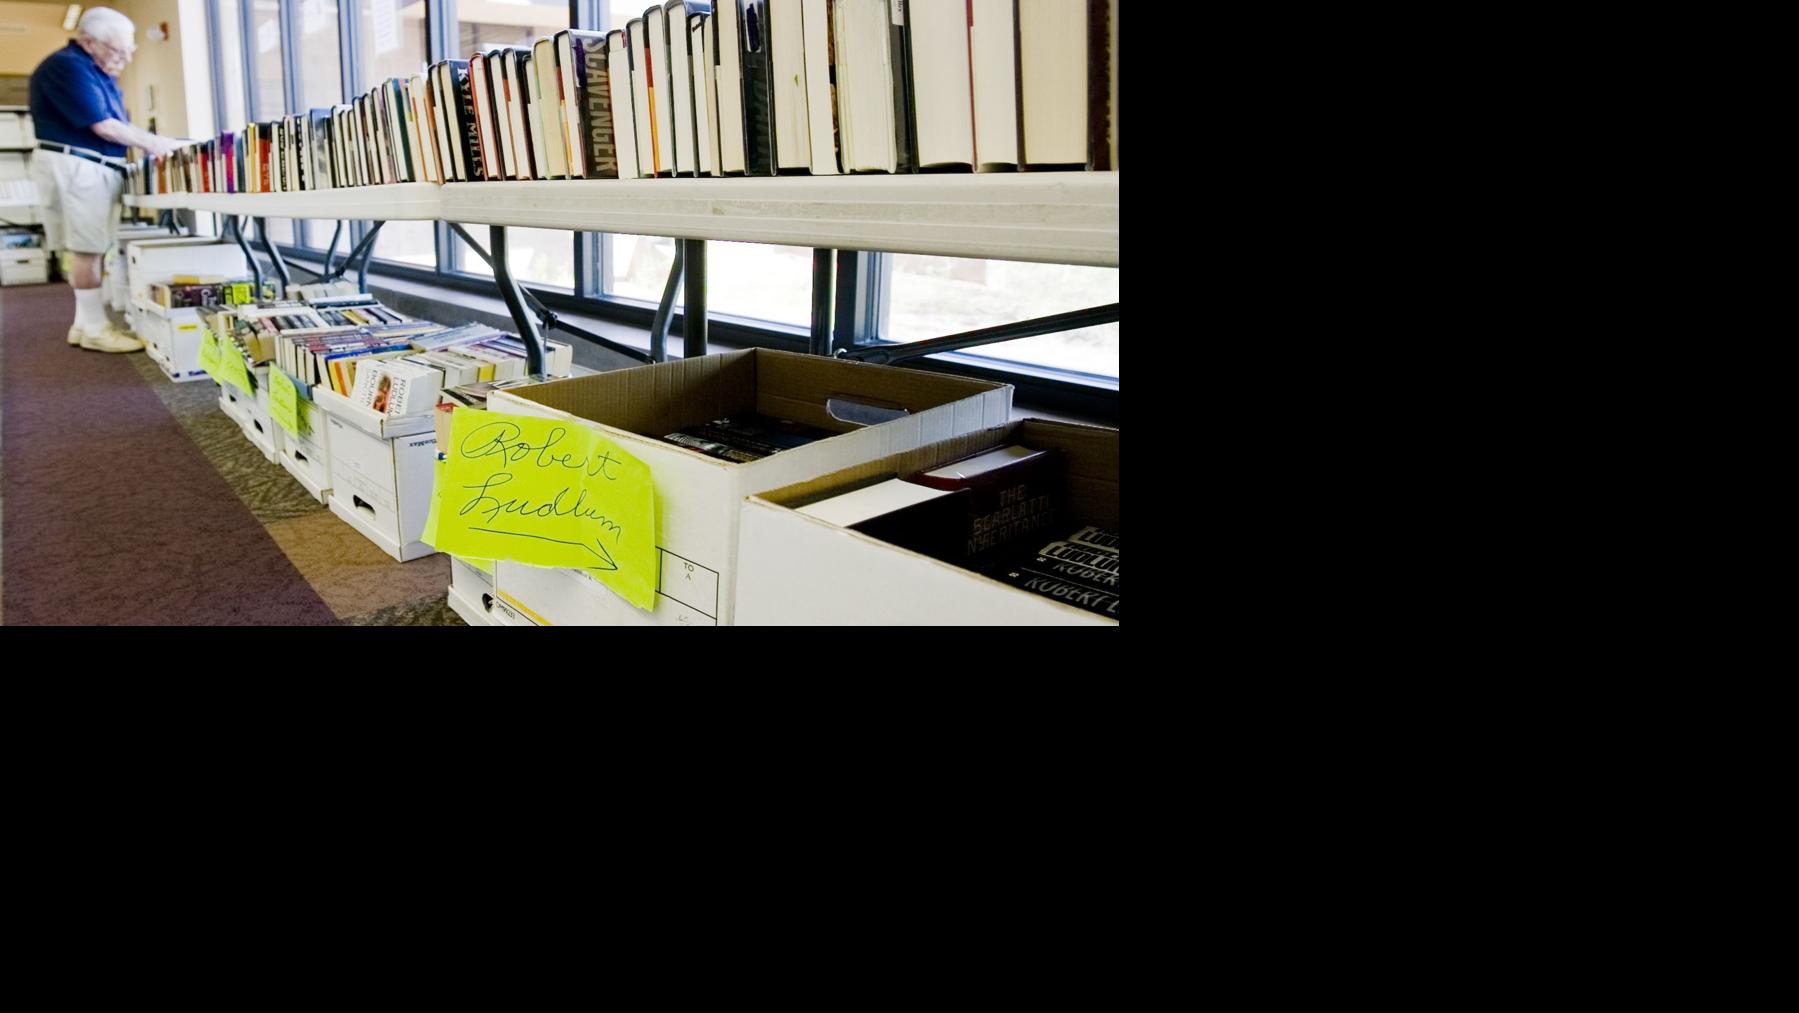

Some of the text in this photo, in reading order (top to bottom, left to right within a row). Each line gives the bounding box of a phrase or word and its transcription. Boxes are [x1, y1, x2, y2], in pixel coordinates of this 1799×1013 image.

[457, 67, 475, 115] KYLE
[582, 38, 617, 172] SCAVENGER
[460, 421, 621, 481] Robert
[459, 472, 622, 544] Ludlum
[1000, 484, 1026, 507] THE
[682, 562, 694, 572] TO
